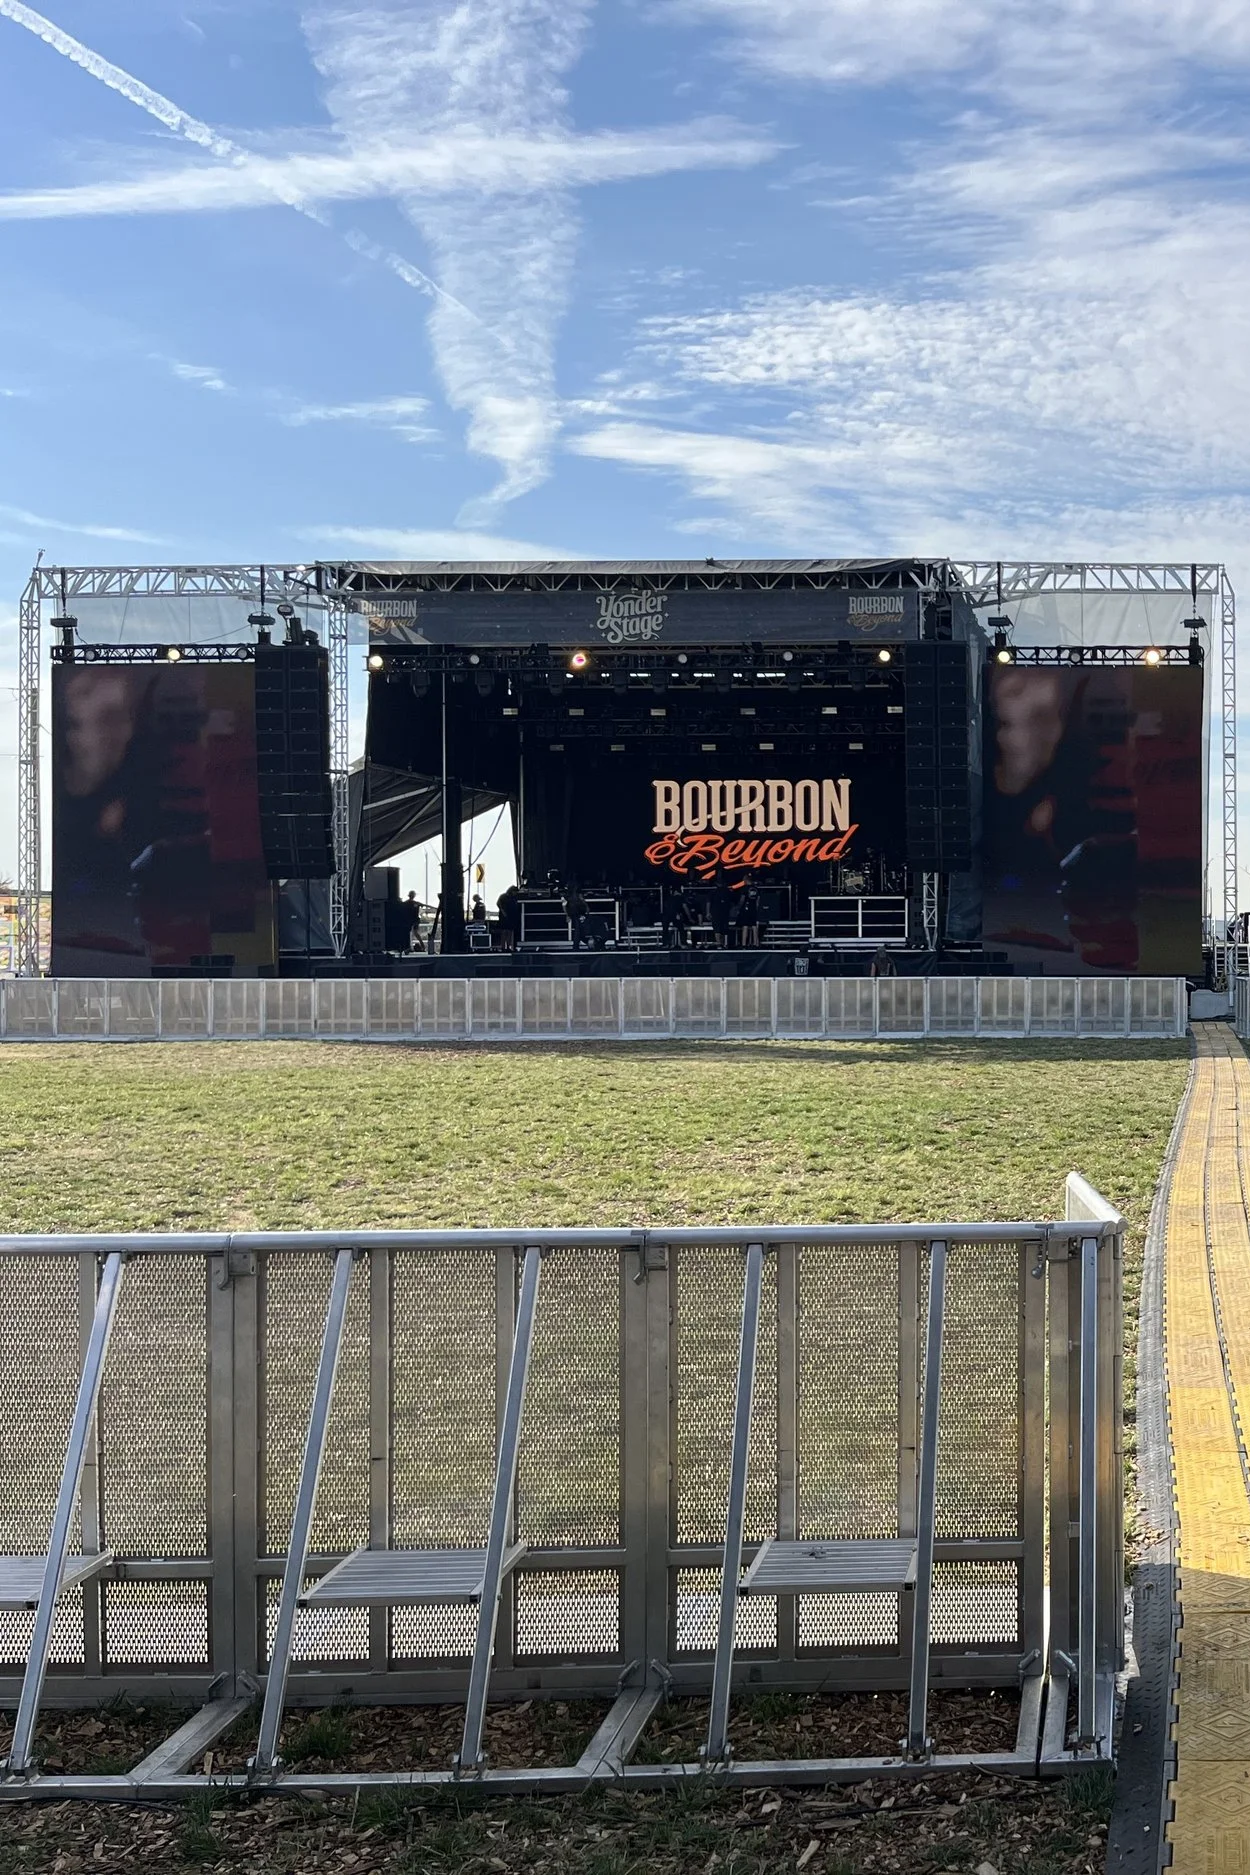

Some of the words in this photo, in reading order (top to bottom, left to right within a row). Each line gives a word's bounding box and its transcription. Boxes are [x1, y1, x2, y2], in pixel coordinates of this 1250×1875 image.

[360, 599, 418, 617] BOURBON
[596, 590, 668, 630] Yonder
[848, 596, 905, 614] BOURBON
[607, 614, 663, 643] Stage
[651, 779, 852, 833] BOURBON
